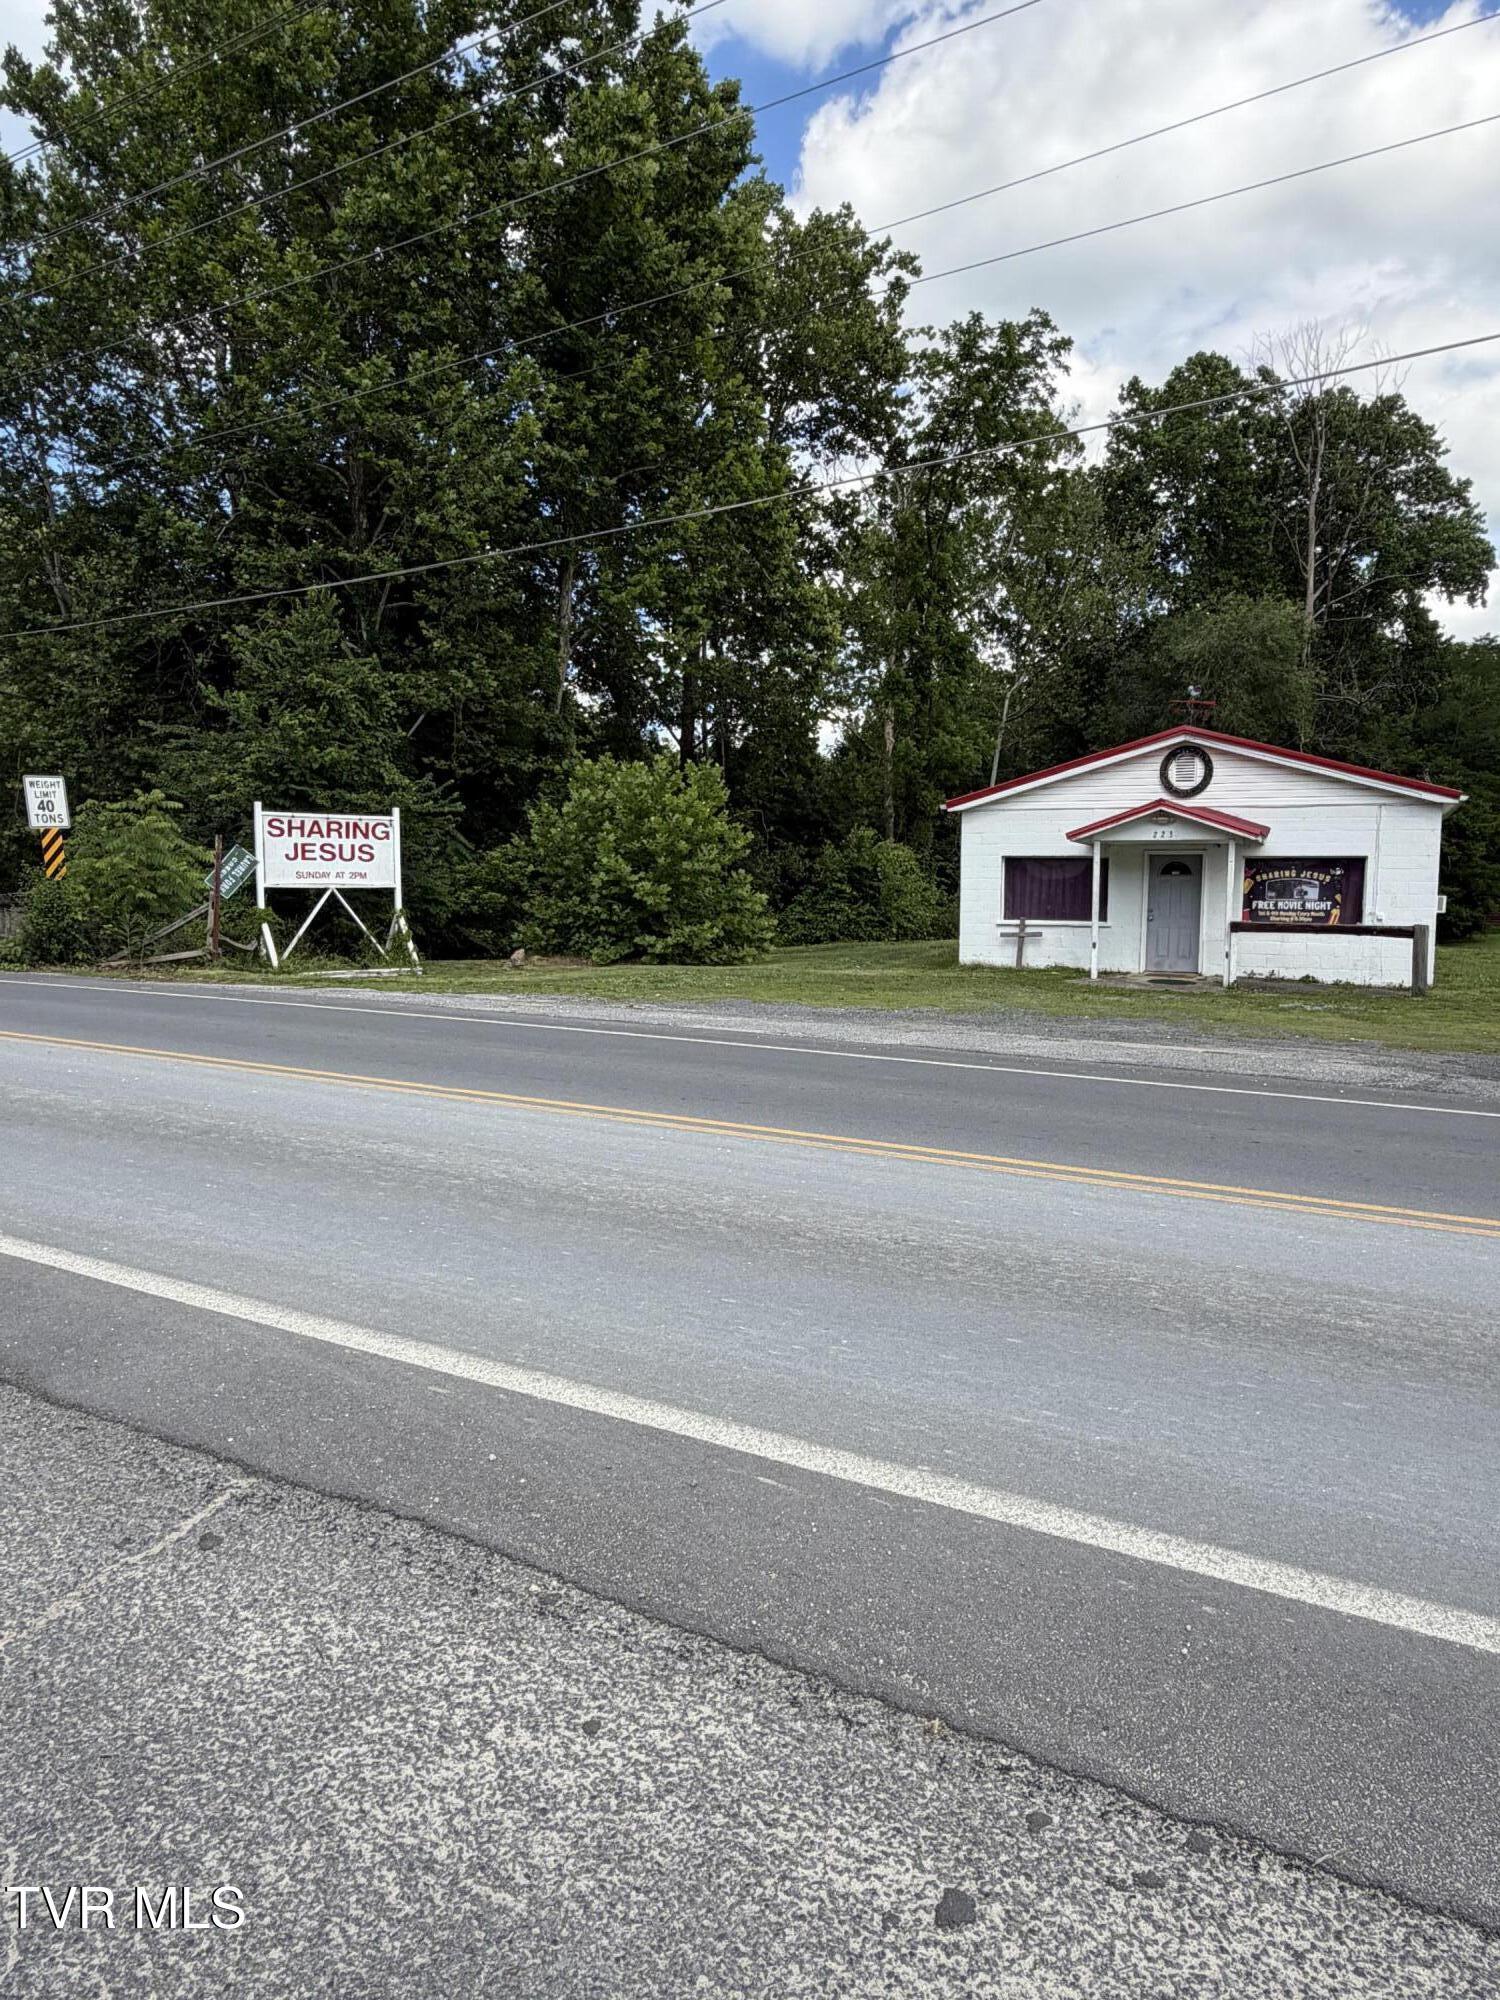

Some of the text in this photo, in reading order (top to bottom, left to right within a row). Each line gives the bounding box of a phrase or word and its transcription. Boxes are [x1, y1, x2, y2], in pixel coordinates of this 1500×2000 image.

[28, 780, 61, 789] WEIGHT
[34, 790, 56, 799] LIMIT
[37, 799, 55, 813] 40
[34, 813, 64, 824] TONS
[267, 818, 390, 841] SHARING
[284, 842, 375, 862] JESUS
[295, 871, 367, 880] SUNDAY AT 2PM
[1255, 870, 1331, 882] SHARING JESUS
[1252, 901, 1332, 910] FREE MOVIE NIGHT
